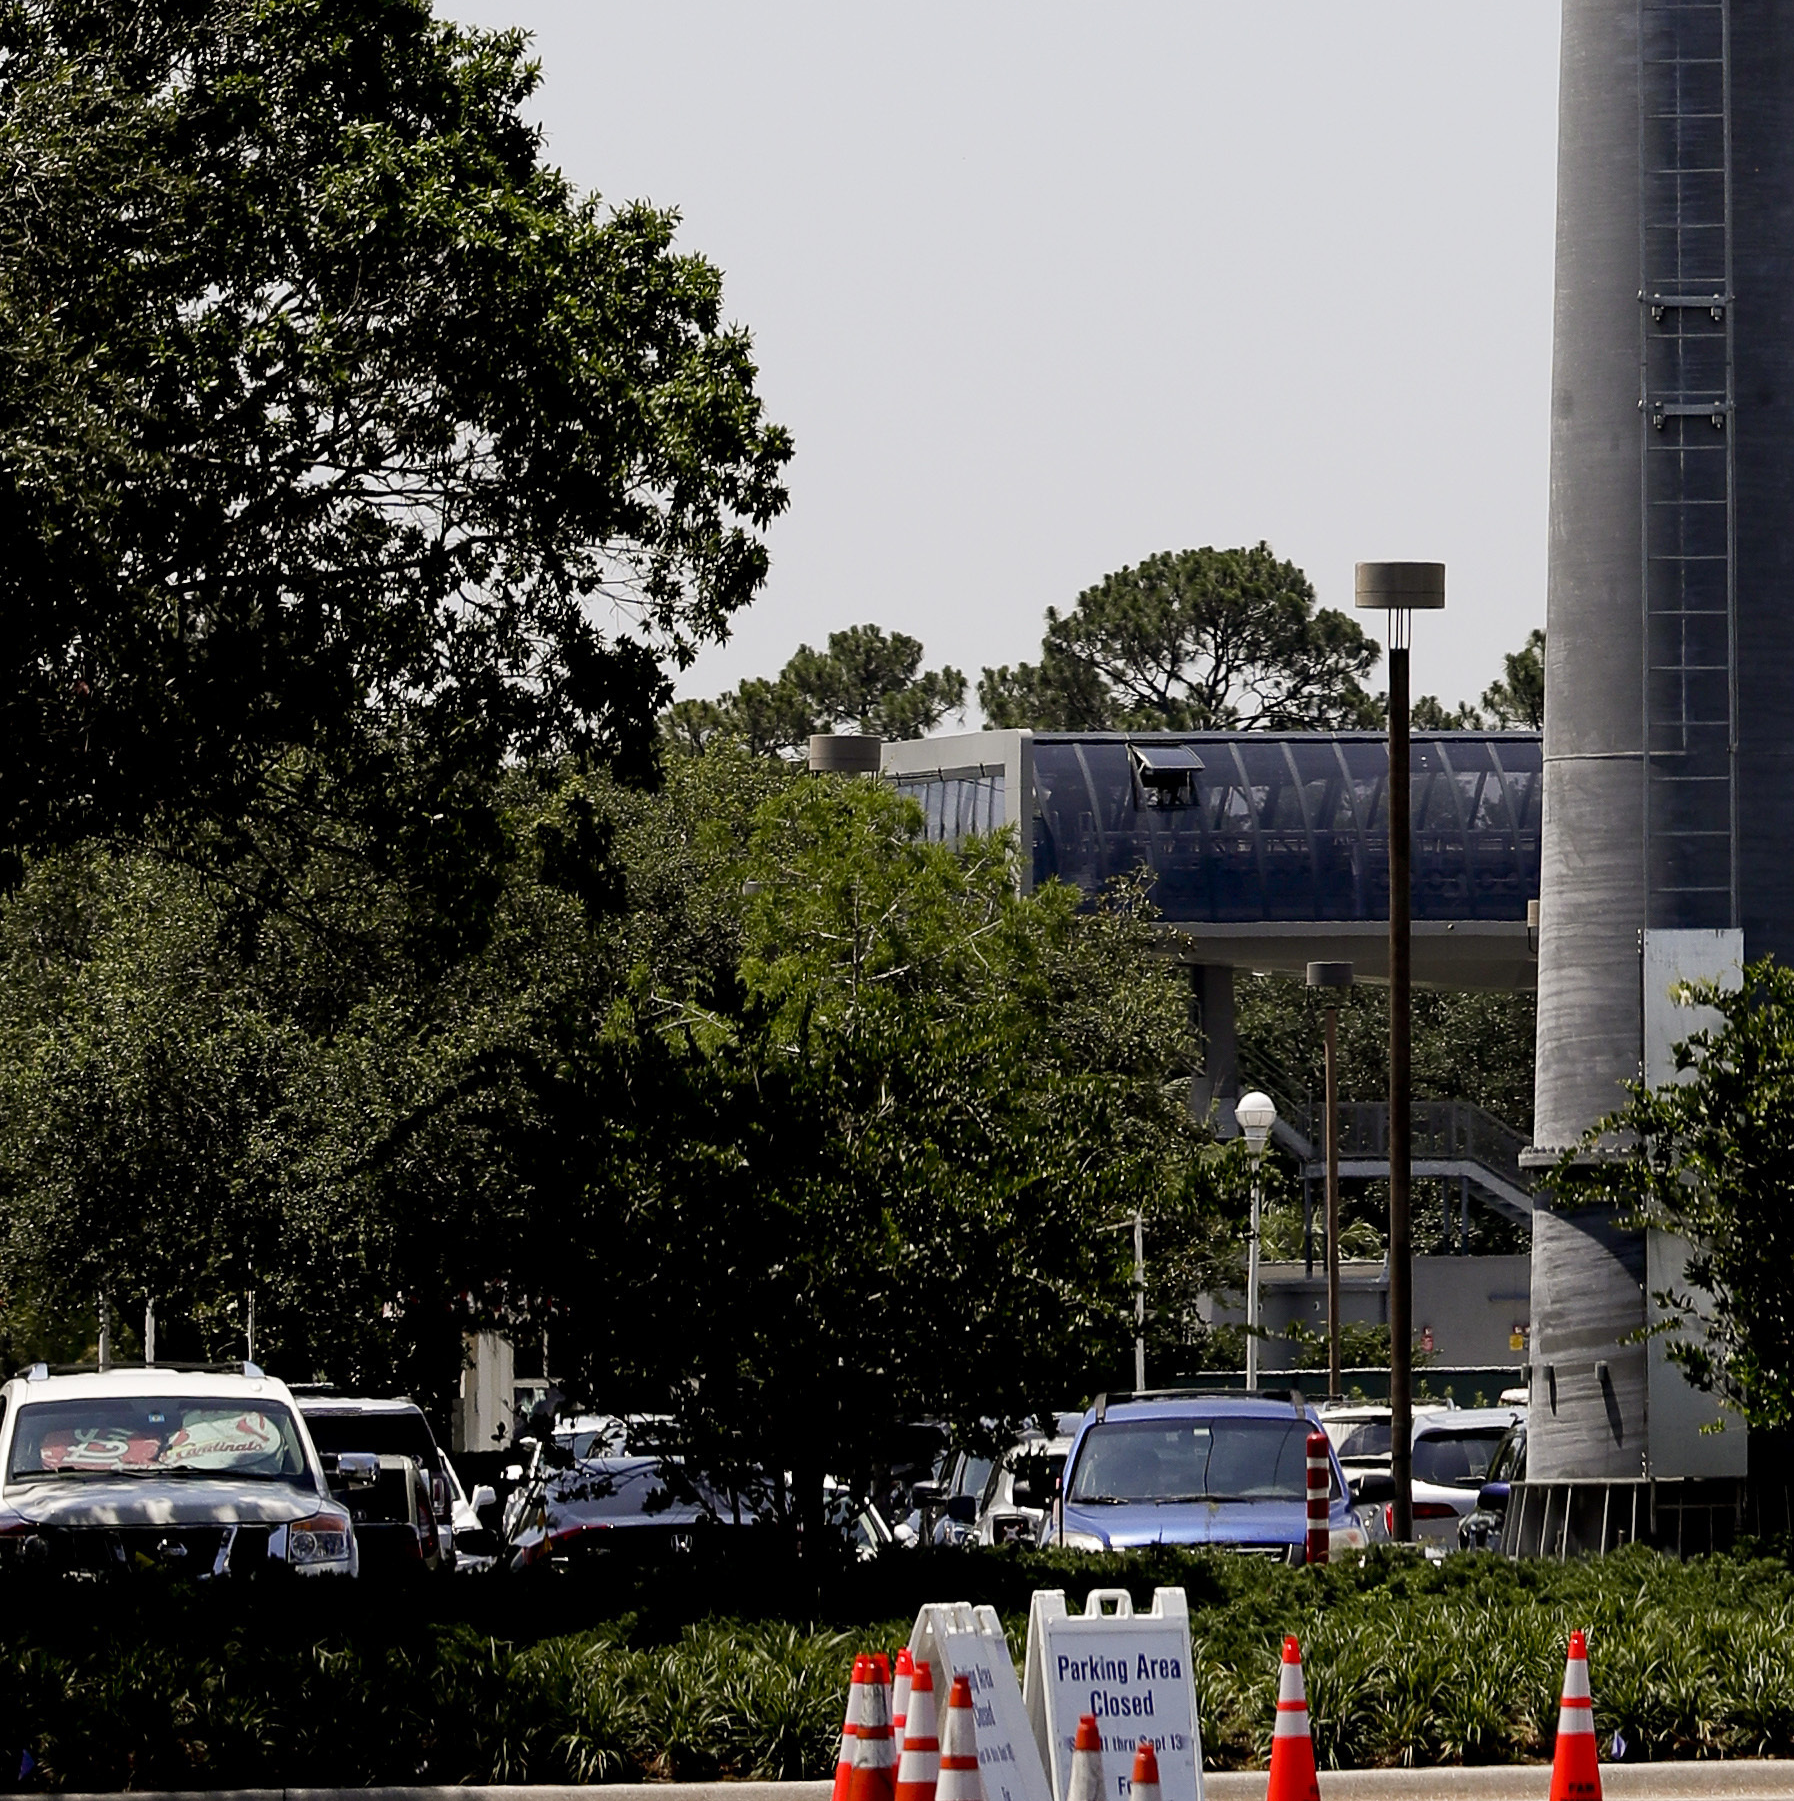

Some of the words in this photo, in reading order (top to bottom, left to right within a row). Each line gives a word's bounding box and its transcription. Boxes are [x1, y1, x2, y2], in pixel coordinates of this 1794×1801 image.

[1057, 1654, 1128, 1684] Parking
[1137, 1653, 1181, 1680] Area
[1090, 1689, 1155, 1717] Closed
[1112, 1735, 1136, 1752] thru
[1171, 1733, 1183, 1751] 13
